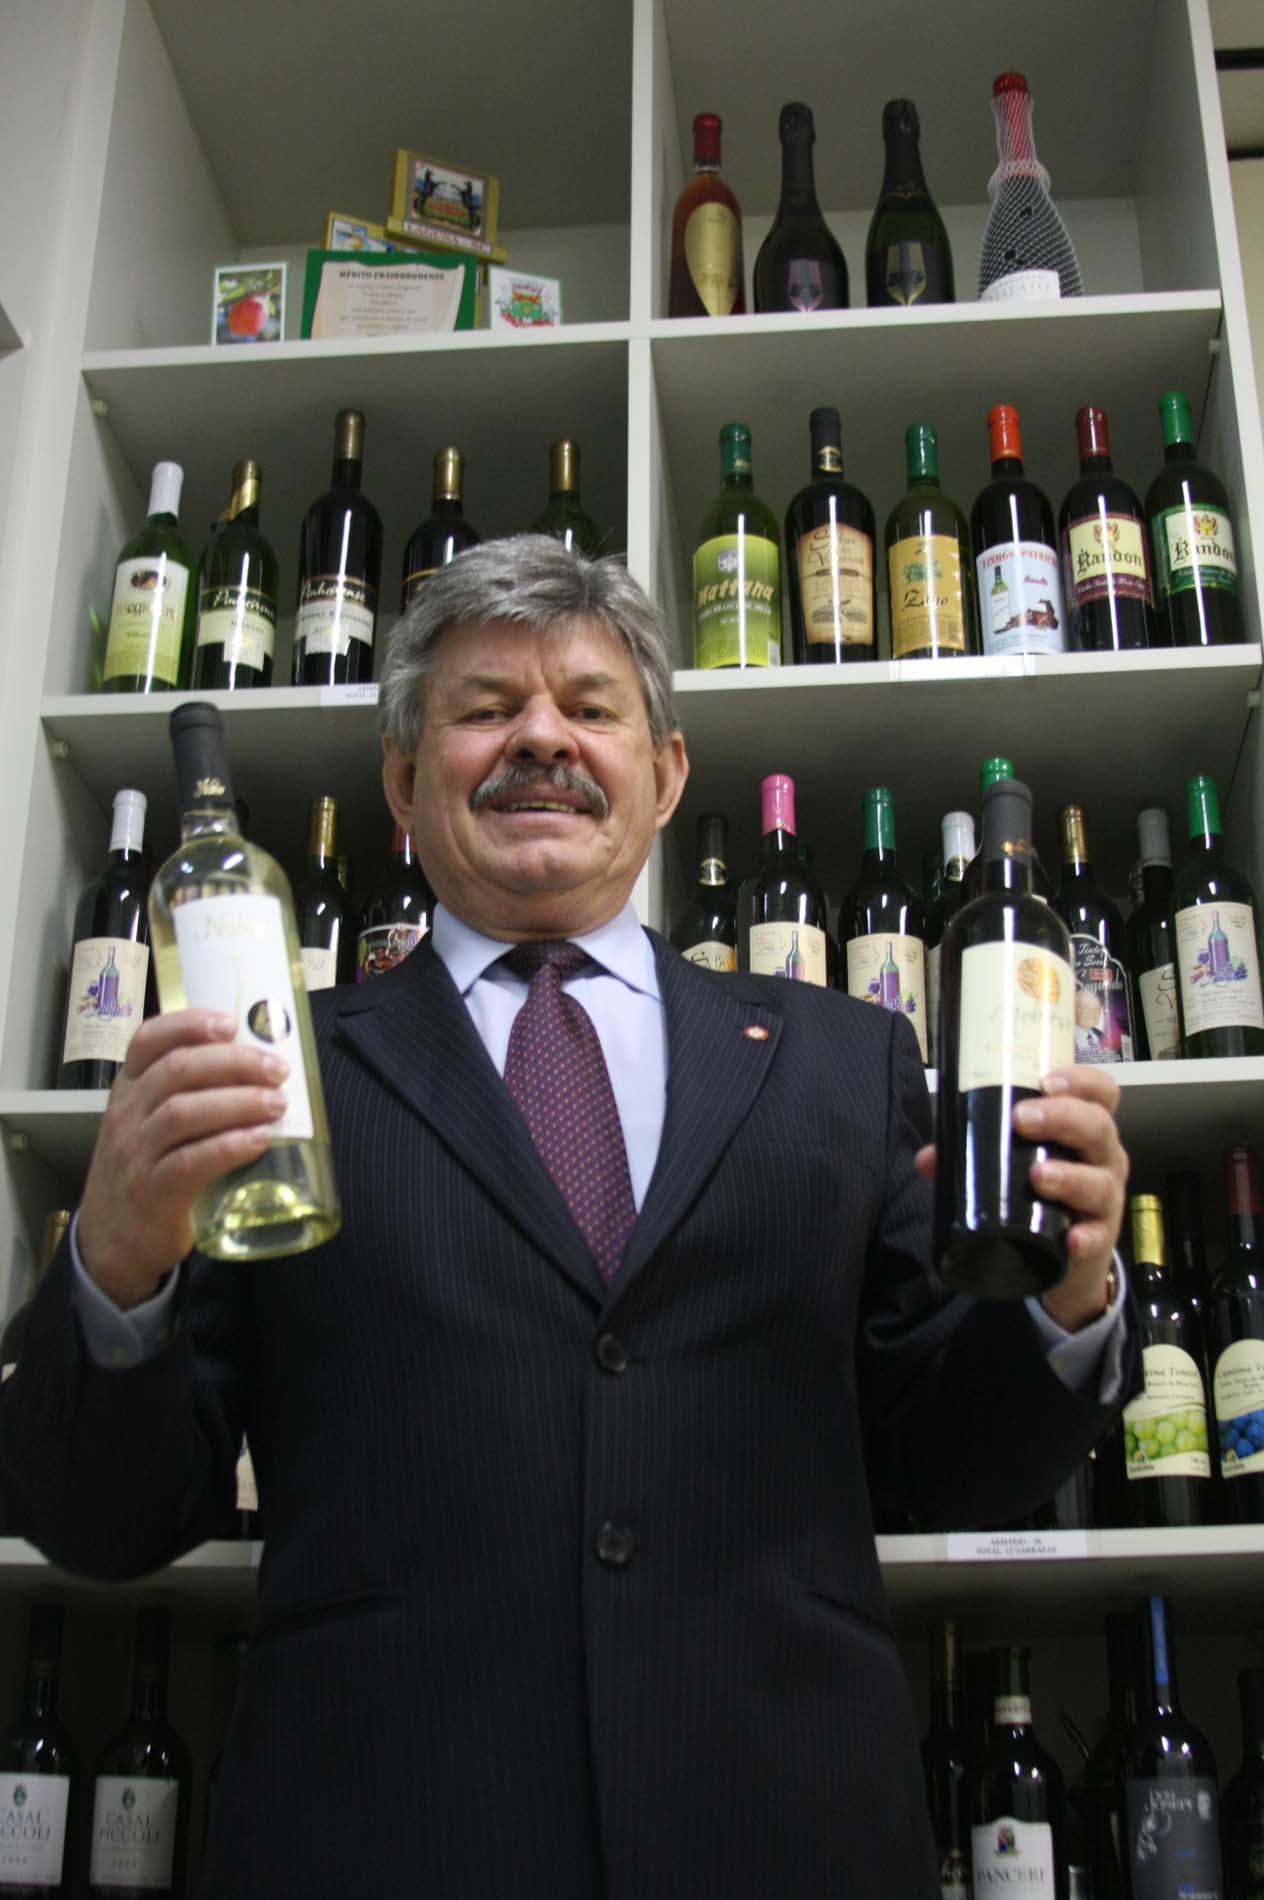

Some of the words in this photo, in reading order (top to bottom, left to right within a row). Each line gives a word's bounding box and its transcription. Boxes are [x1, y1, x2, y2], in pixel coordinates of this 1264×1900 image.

[1175, 537, 1235, 564] Rndon
[0, 1826, 51, 1841] CCOLI
[977, 1863, 1045, 1883] PANCERI
